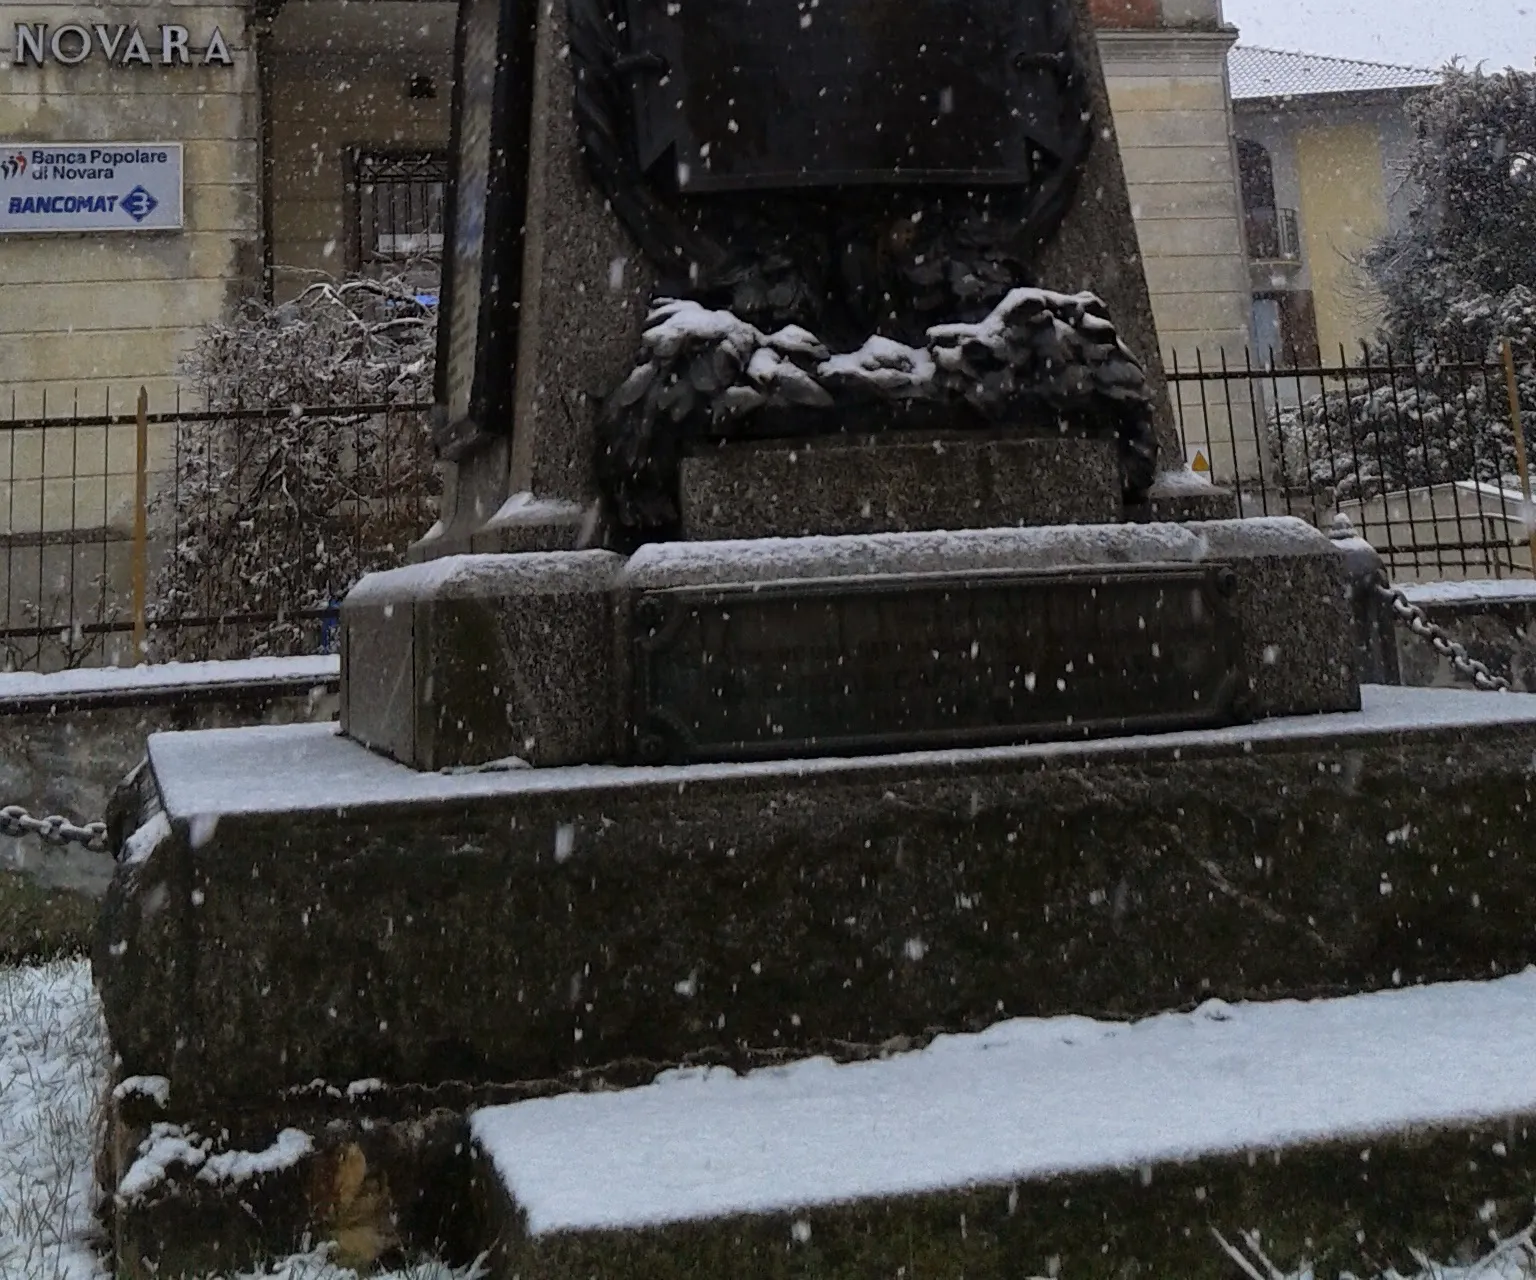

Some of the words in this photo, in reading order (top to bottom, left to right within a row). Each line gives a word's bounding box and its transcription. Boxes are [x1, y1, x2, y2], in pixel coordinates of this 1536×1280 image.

[14, 22, 234, 67] NOVARA
[31, 150, 87, 165] Banca
[91, 148, 168, 166] Popolare
[32, 166, 48, 180] di
[53, 166, 115, 180] Novara
[8, 195, 119, 214] BANCOMAT
